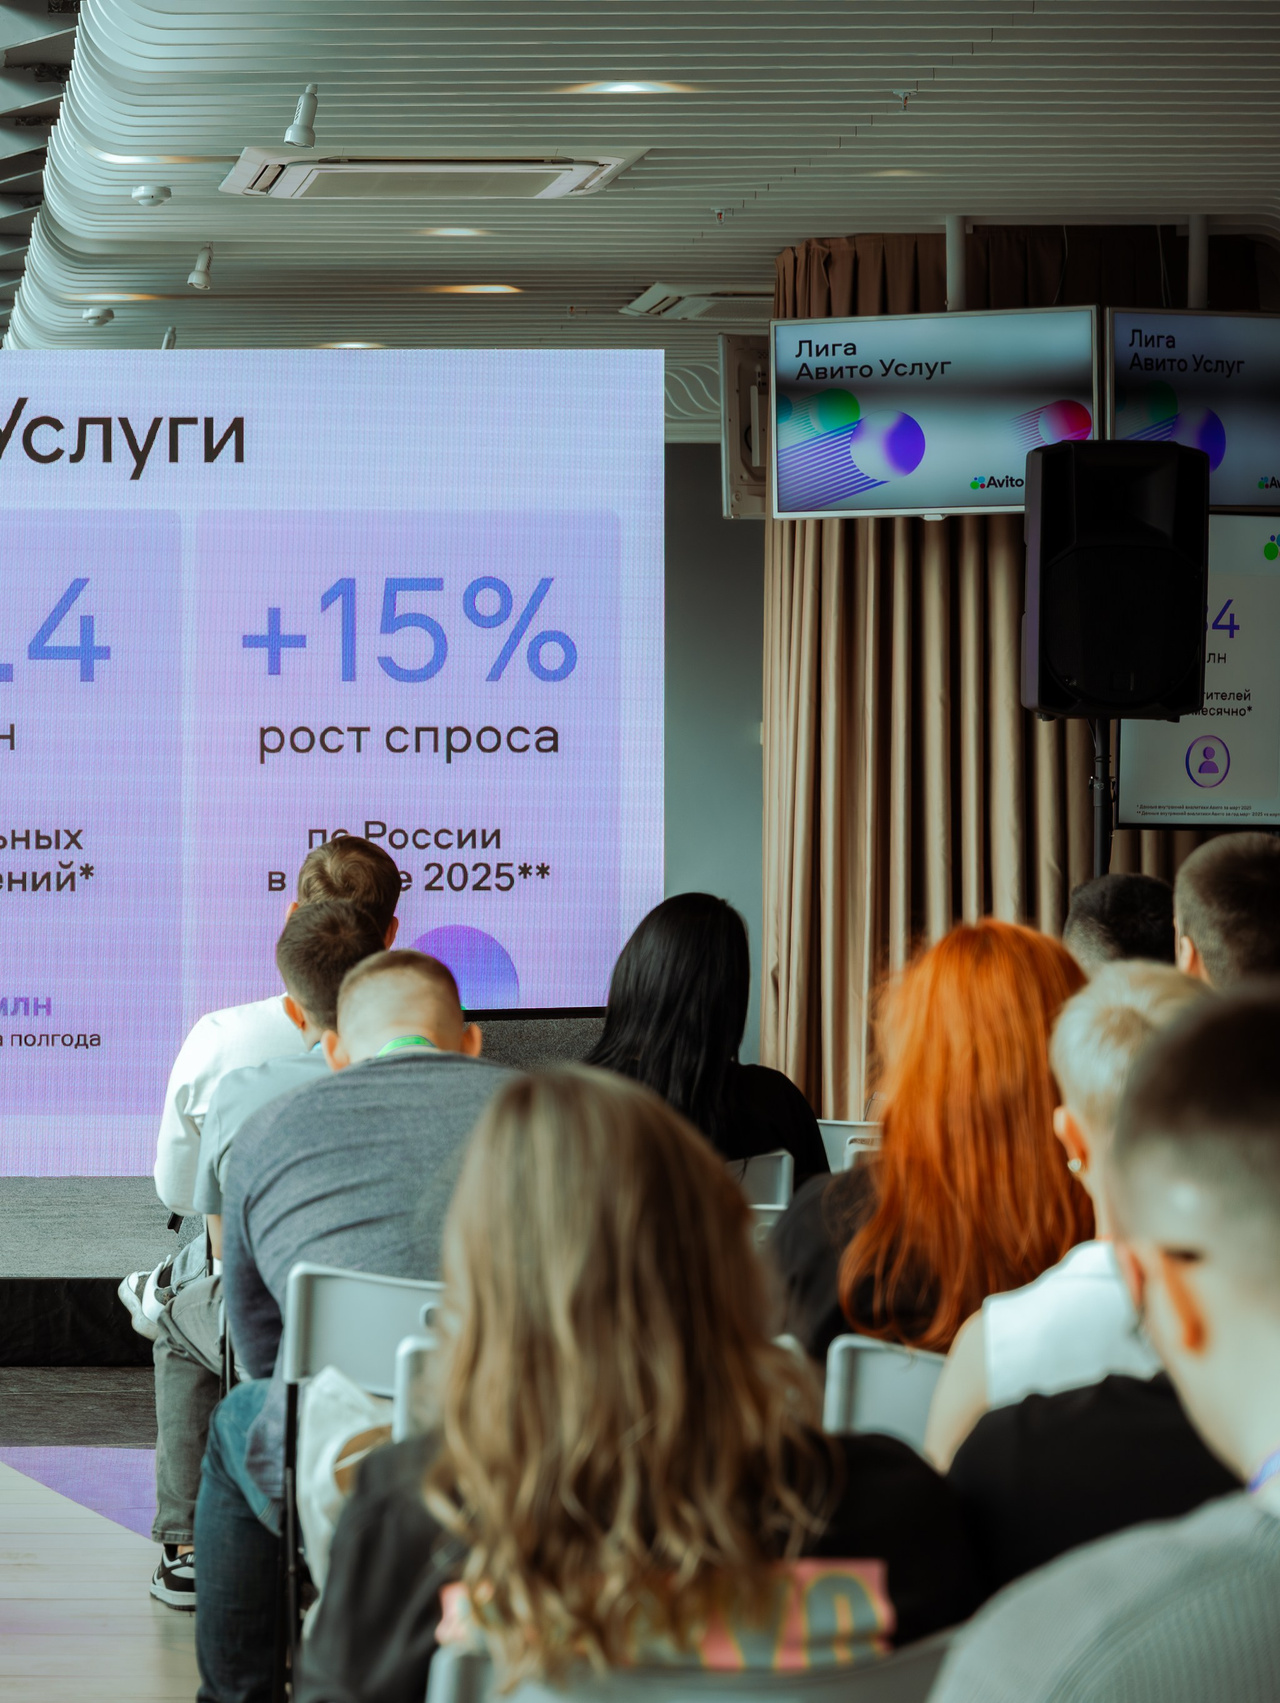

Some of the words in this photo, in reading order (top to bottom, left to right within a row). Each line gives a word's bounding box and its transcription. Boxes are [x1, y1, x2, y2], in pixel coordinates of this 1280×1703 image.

[794, 339, 858, 360] Лига
[1128, 328, 1176, 350] Лига
[795, 361, 874, 382] Авито
[879, 357, 952, 379] Услуг
[1128, 352, 1188, 373] Авито
[1191, 353, 1245, 378] Услуг
[986, 475, 1024, 489] Avito
[242, 575, 578, 685] +15%
[1204, 599, 1241, 639] 4
[1206, 652, 1228, 664] лн
[1204, 688, 1252, 702] ителей
[259, 725, 371, 764] рост
[385, 725, 559, 764] спроса
[364, 821, 503, 850] России
[267, 871, 287, 892] в
[10, 1033, 102, 1050] полгода
